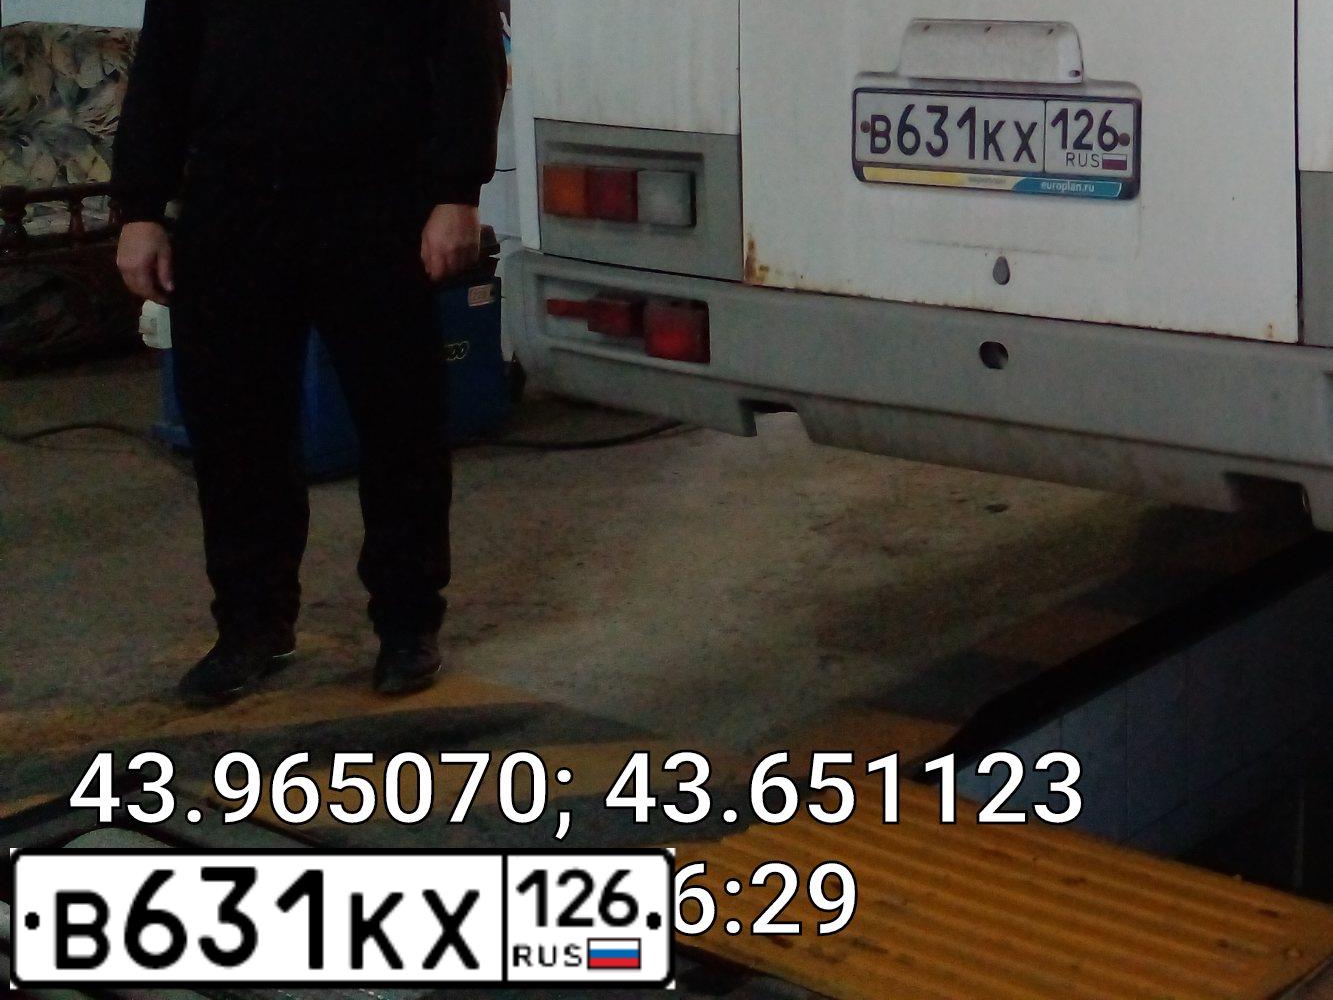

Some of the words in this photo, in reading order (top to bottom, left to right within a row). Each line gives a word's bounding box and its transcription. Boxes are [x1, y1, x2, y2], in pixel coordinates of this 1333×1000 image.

[869, 103, 1038, 164] В631КХ
[1050, 107, 1119, 152] 126
[1065, 152, 1100, 169] RUS
[1041, 180, 1095, 194] europlan.ru
